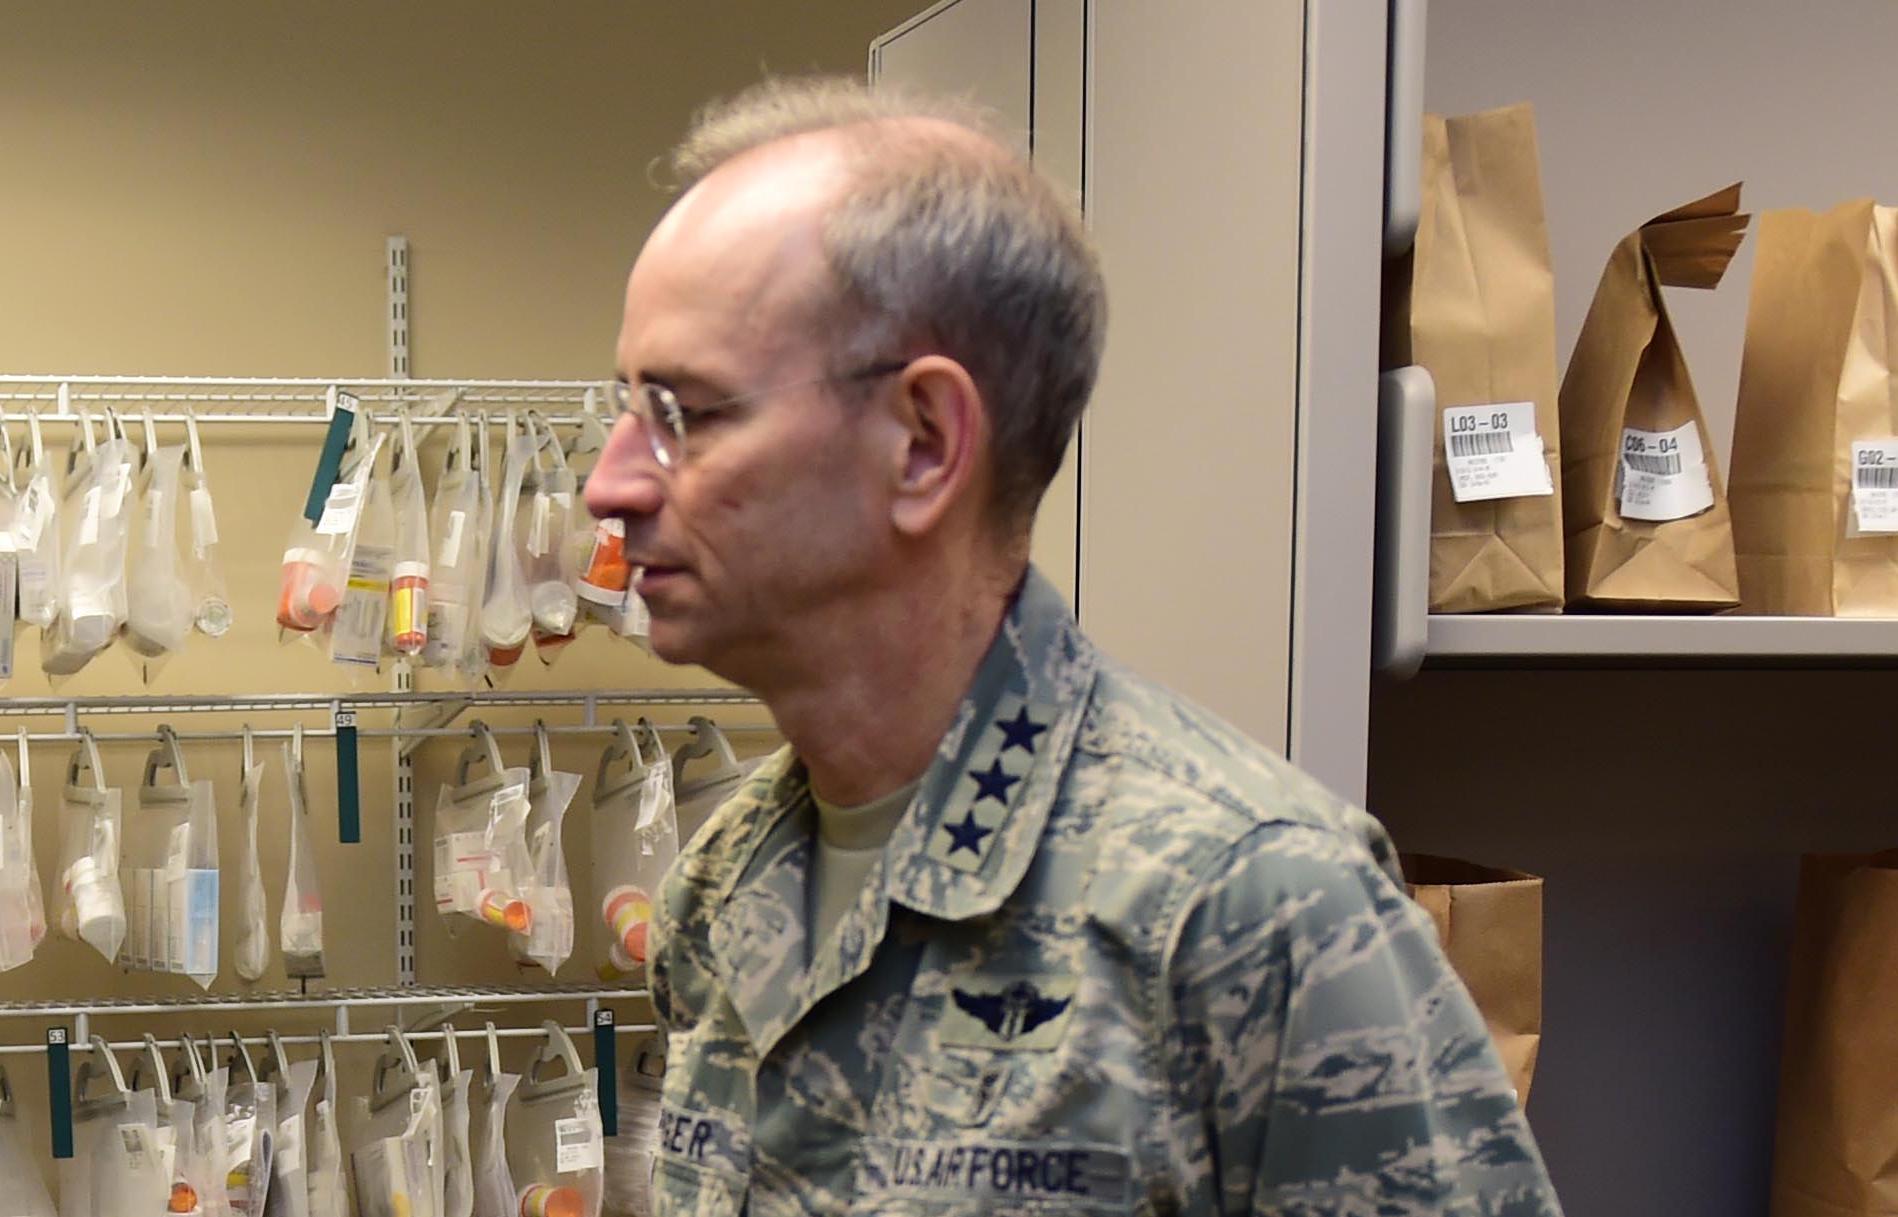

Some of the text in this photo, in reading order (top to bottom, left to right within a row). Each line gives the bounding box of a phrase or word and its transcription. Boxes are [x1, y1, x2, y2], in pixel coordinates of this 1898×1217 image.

[336, 713, 352, 726] 49
[597, 1012, 612, 1025] 54
[49, 1029, 65, 1042] 53
[968, 1146, 1090, 1196] FORCE
